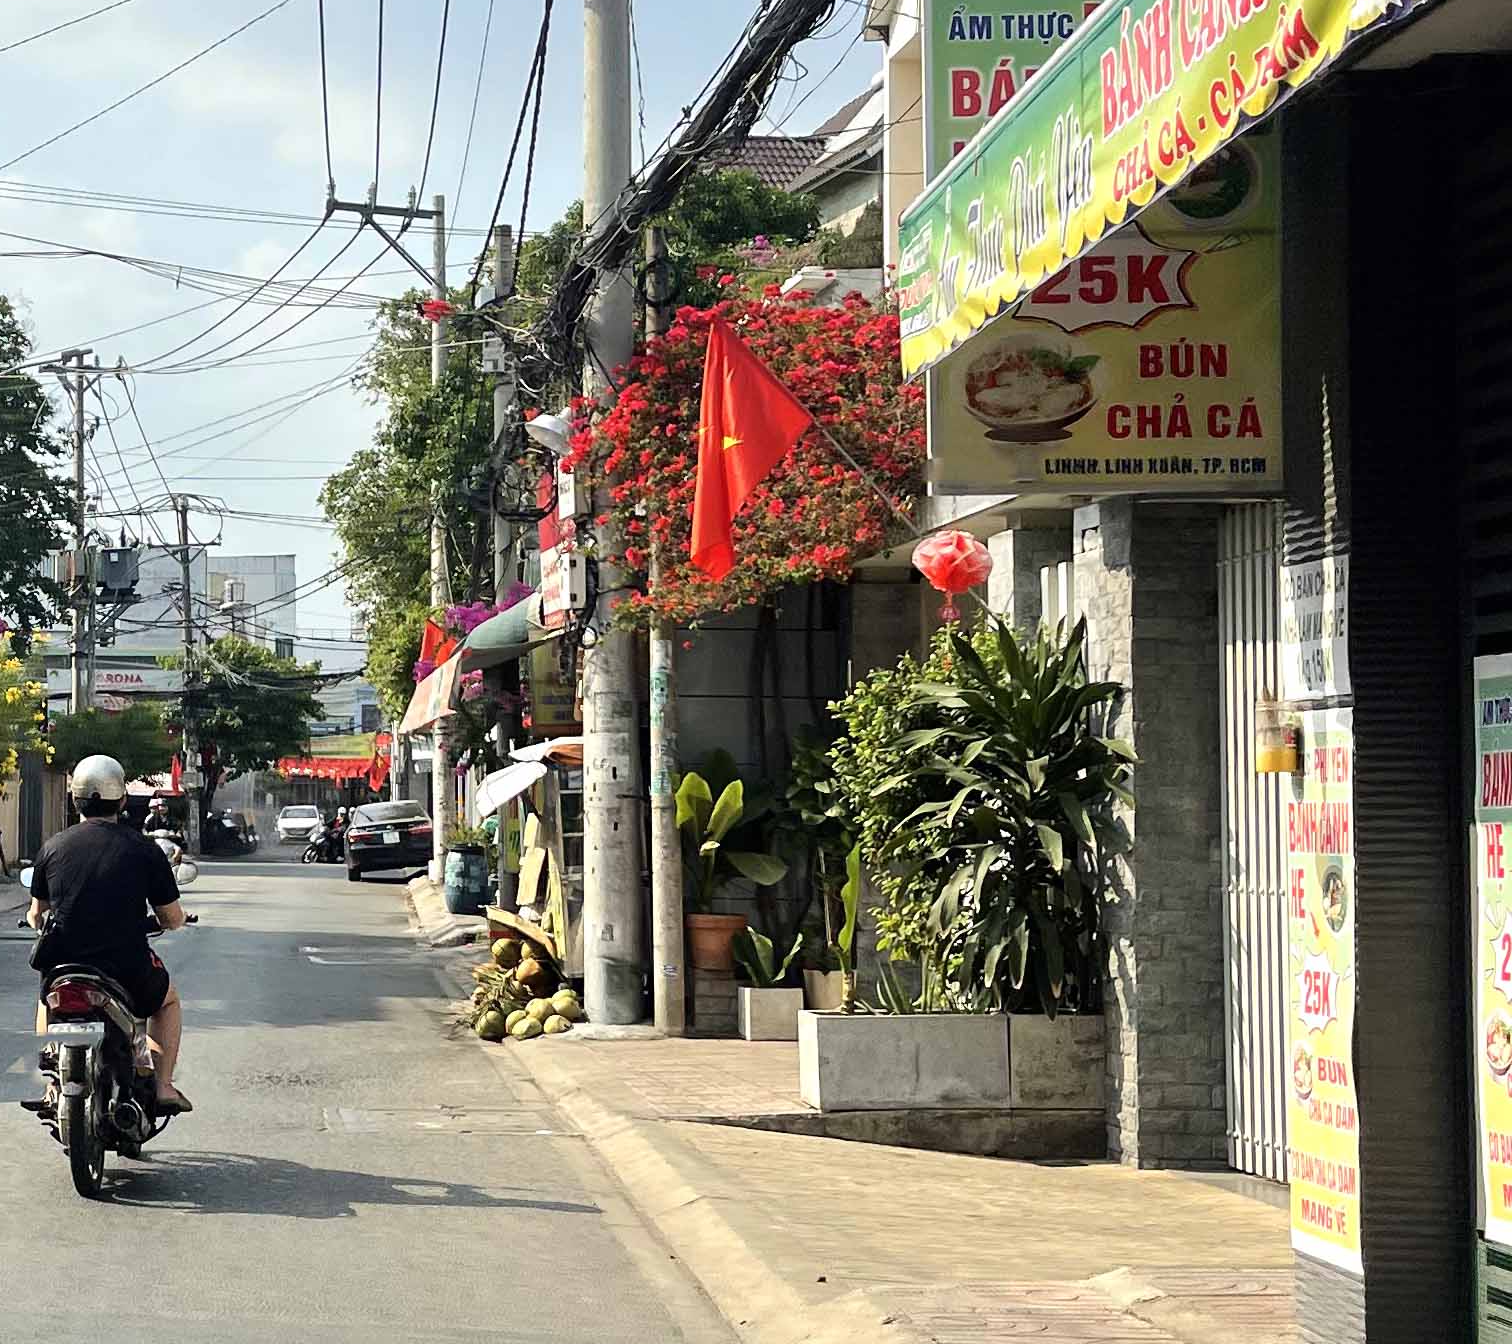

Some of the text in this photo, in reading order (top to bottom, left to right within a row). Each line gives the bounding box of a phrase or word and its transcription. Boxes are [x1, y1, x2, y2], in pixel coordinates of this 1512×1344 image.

[949, 6, 1073, 45] ẨM THỰC
[1101, 8, 1172, 137] BÁNH
[1158, 97, 1196, 167] CÁ
[1031, 256, 1170, 304] 25K
[1139, 337, 1228, 378] BÚN
[1107, 393, 1262, 439] CHẢ CÁ
[1304, 969, 1331, 1017] 25K
[1301, 1198, 1333, 1230] MANG
